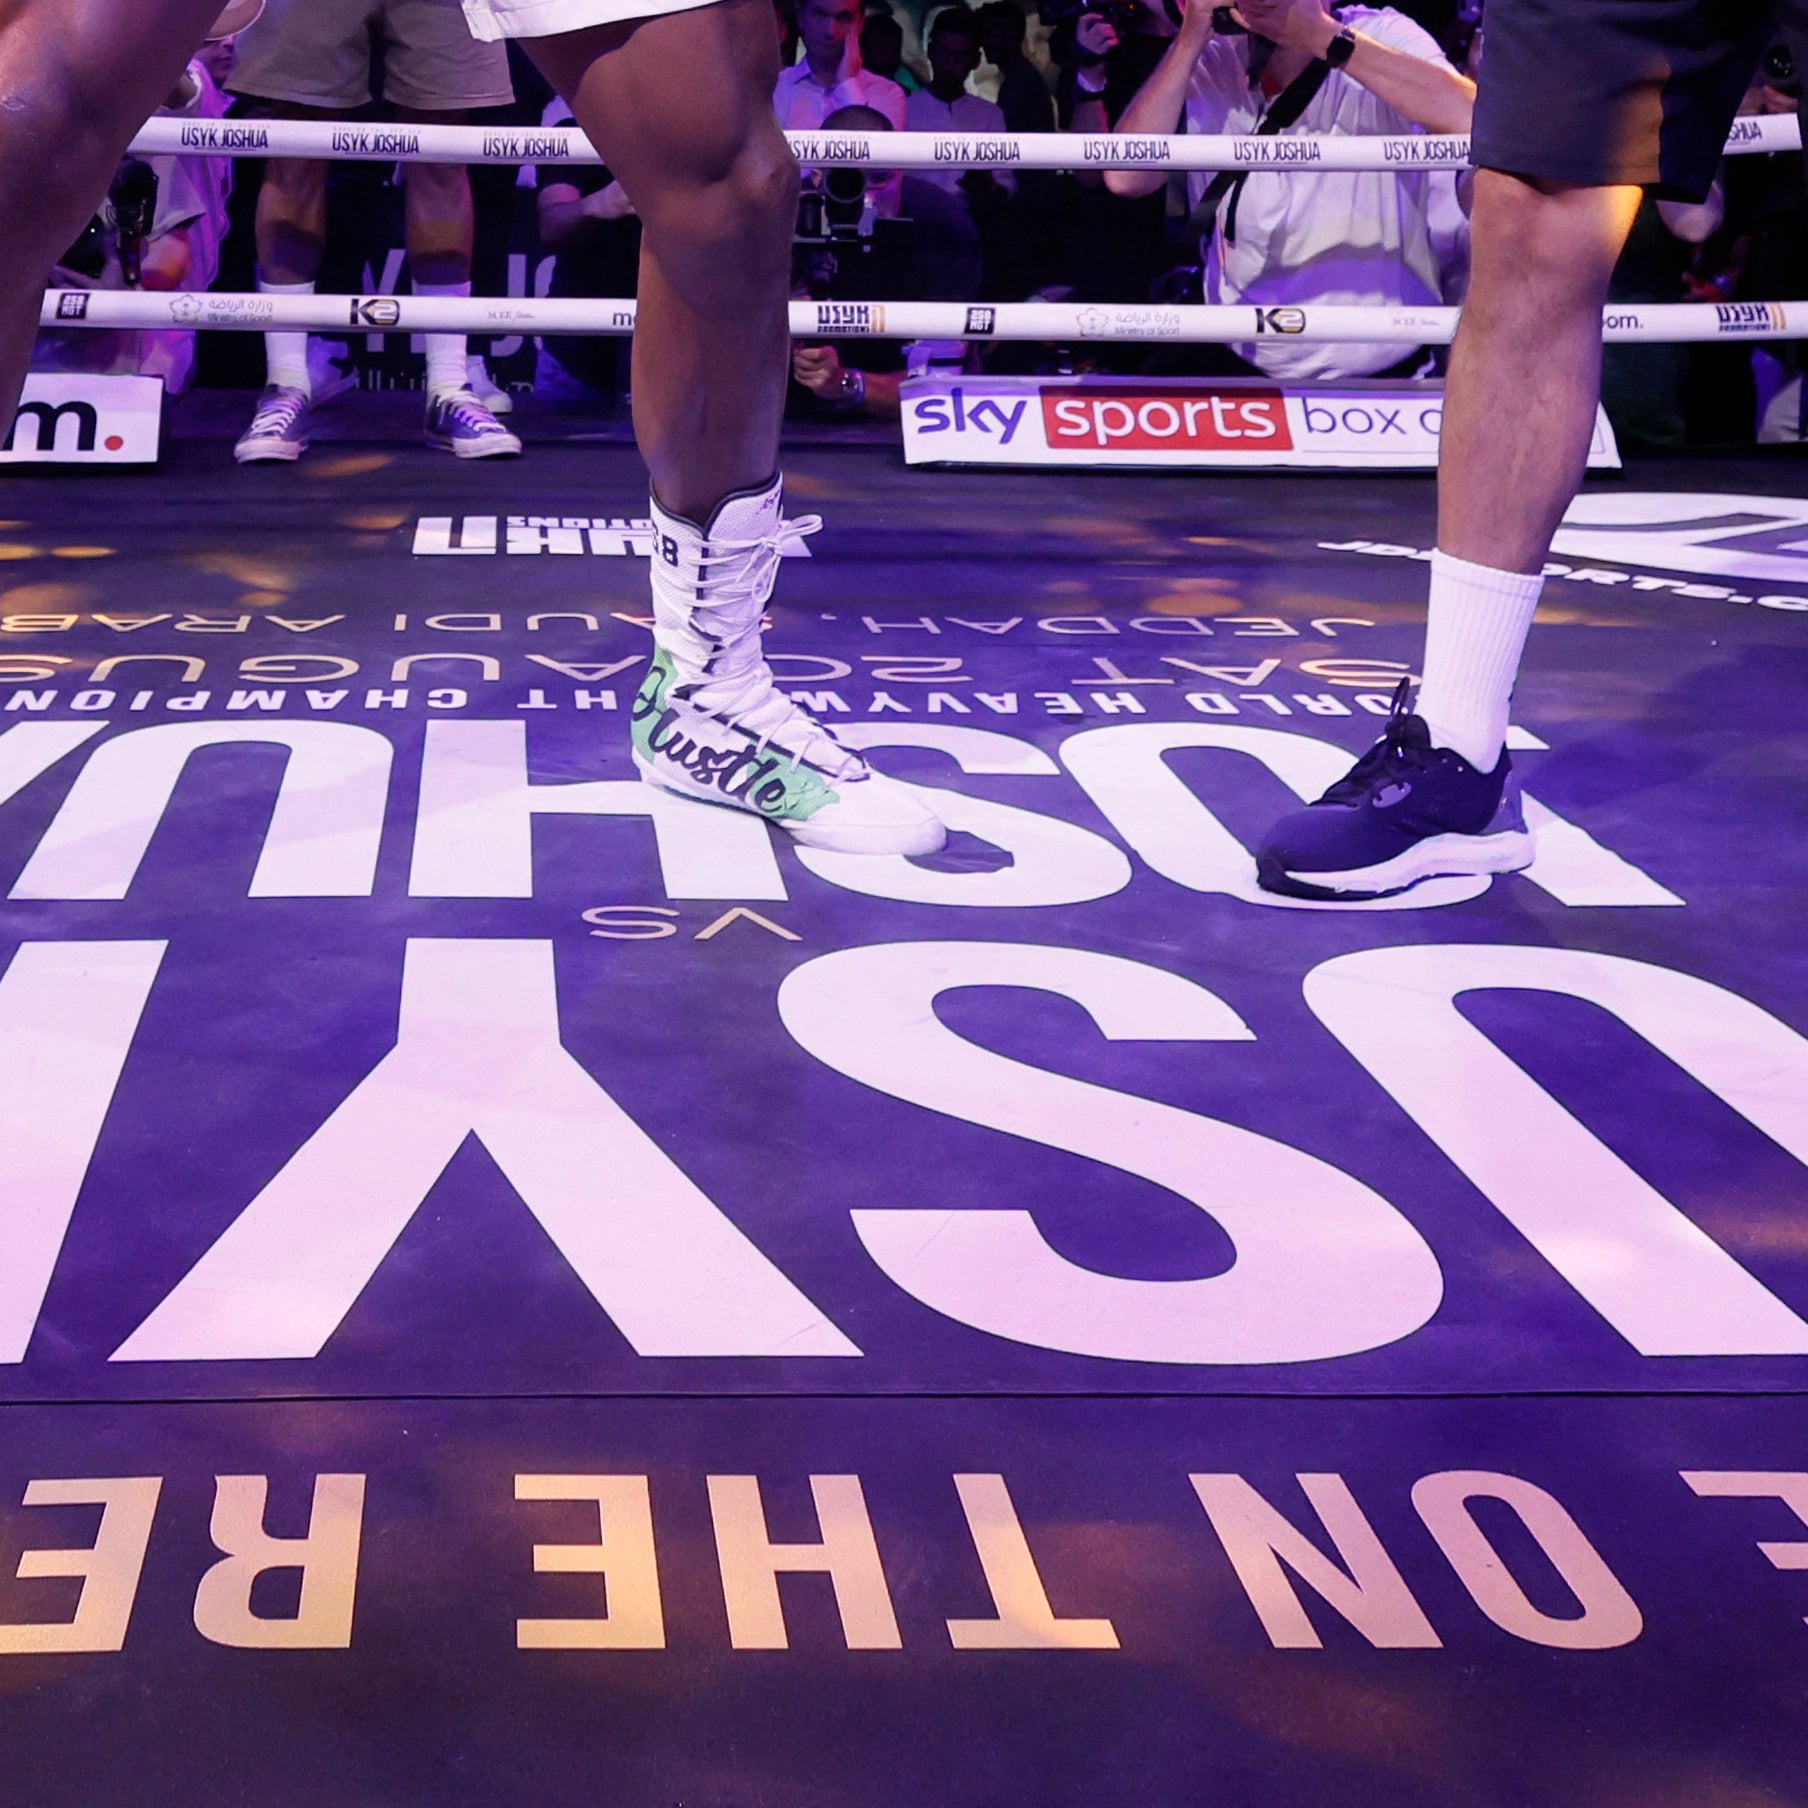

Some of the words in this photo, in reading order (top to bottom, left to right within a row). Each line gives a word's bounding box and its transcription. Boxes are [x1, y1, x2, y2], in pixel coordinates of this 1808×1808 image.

[181, 127, 218, 146] USYK
[219, 129, 269, 149] JOSHUA
[332, 131, 370, 152] USYK
[371, 134, 420, 154] JOSHUA
[483, 137, 520, 156] USYK
[521, 138, 570, 157] JOSHUA
[822, 141, 870, 160] JOSHUA
[934, 141, 971, 161] USYK
[973, 141, 1021, 161] JOSHUA
[1084, 141, 1121, 161] USYK
[1123, 141, 1171, 161] JOSHUA
[1234, 141, 1271, 162] USYK
[1272, 141, 1321, 162] JOSHUA
[1383, 141, 1420, 161] USYK
[1422, 140, 1470, 160] JOSHUA
[817, 305, 870, 325] USYK
[969, 309, 991, 322] 258
[914, 387, 1028, 445] sky
[1054, 395, 1277, 447] sports
[1303, 396, 1406, 435] box
[821, 614, 1376, 638] JEDDAH,
[1071, 656, 1422, 688] SAT
[580, 904, 803, 942] VS
[511, 1473, 1122, 1652] THE
[1186, 1470, 1646, 1653] ON
